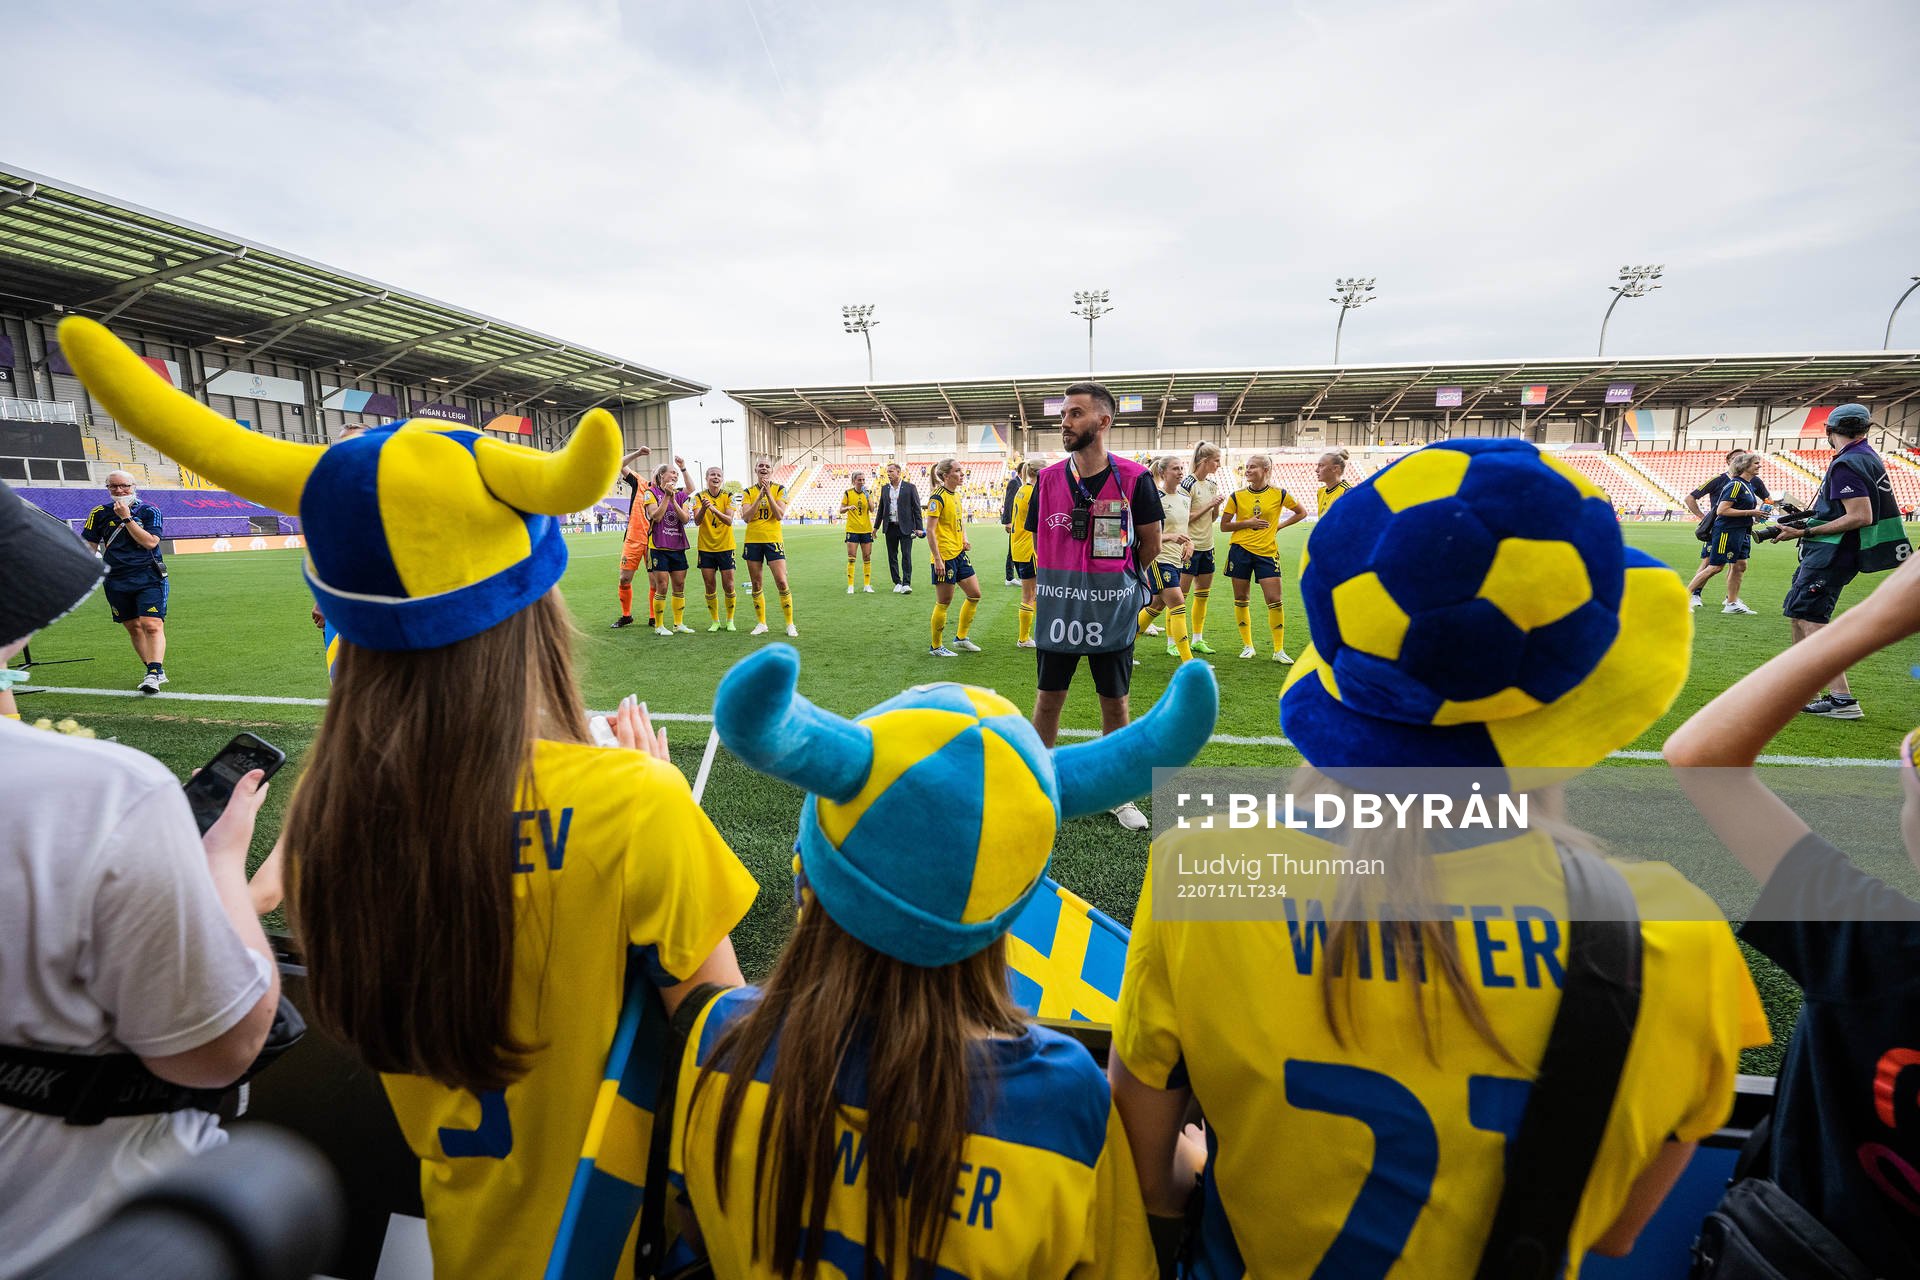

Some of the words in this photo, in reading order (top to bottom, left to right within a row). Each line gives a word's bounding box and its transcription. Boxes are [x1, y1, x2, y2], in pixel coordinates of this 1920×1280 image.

[1609, 388, 1629, 396] FIFA
[419, 407, 441, 417] WIGAN
[448, 411, 466, 420] LEIGH
[758, 508, 769, 520] 18
[1895, 543, 1913, 562] 8
[1065, 587, 1088, 601] FAN
[1050, 618, 1104, 647] 008
[0, 1062, 65, 1099] ARK
